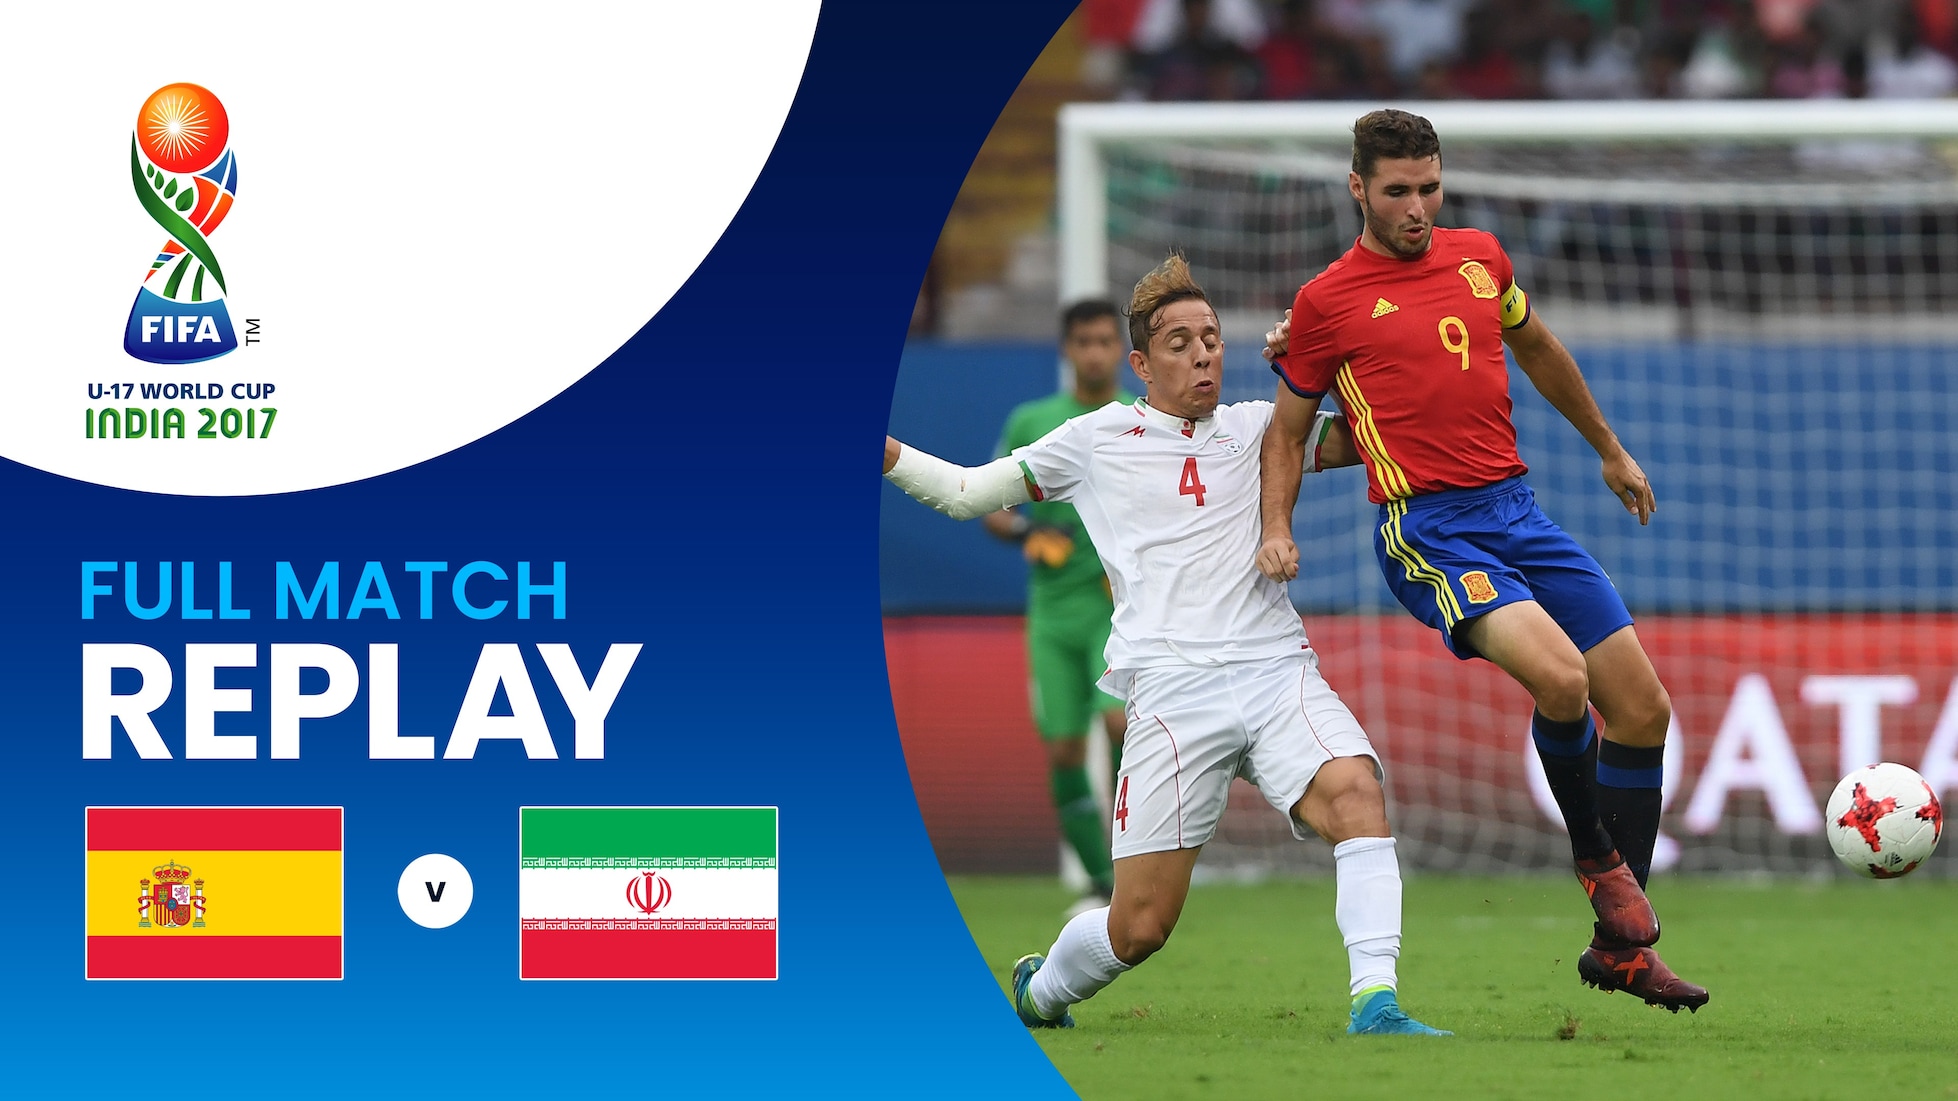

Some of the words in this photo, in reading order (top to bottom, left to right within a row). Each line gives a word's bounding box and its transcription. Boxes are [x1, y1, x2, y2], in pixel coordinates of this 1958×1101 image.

[1371, 304, 1400, 319] adidas
[1438, 316, 1470, 371] 9
[1179, 457, 1206, 507] 4
[1525, 673, 1958, 872] AT
[1115, 776, 1129, 831] 4
